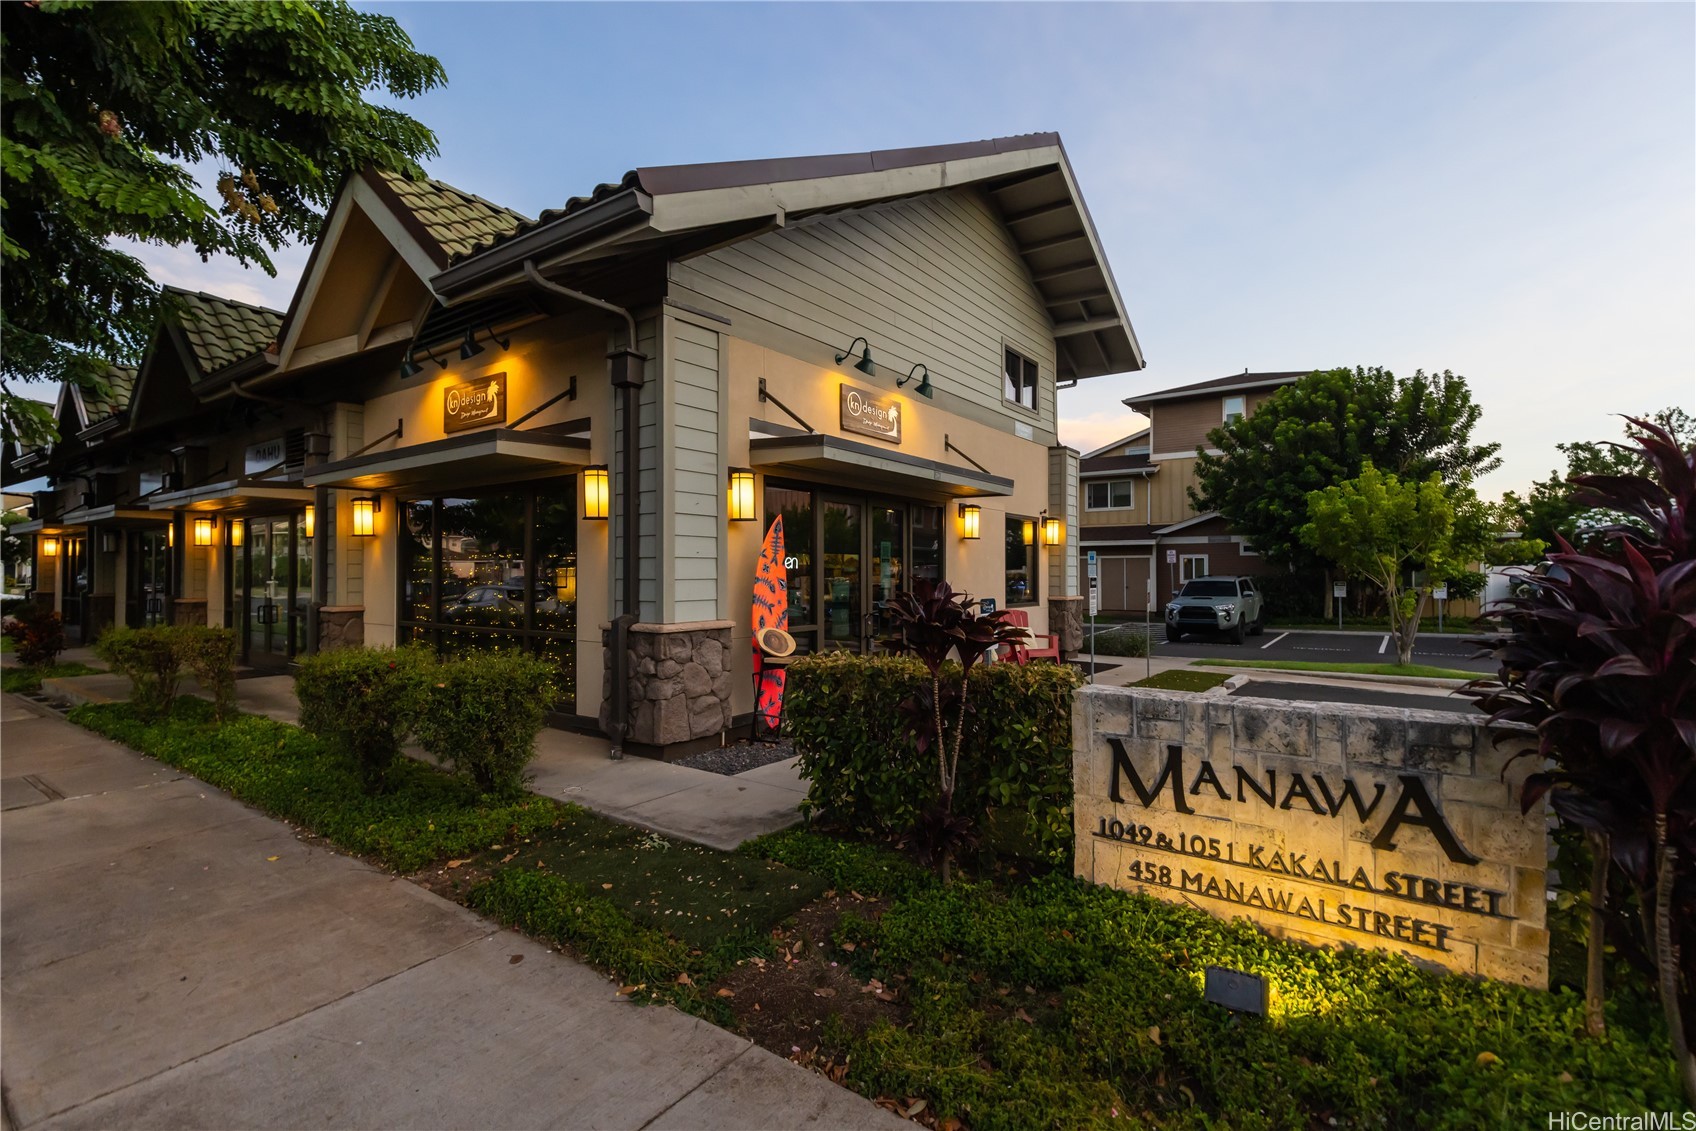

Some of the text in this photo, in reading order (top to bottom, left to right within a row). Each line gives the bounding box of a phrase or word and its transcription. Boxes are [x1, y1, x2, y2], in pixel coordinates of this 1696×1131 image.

[461, 392, 486, 406] design
[862, 401, 888, 420] design
[255, 445, 280, 464] OAHU
[784, 556, 799, 570] en
[1248, 844, 1375, 893] KAKALA
[1384, 870, 1507, 918] STREET
[1128, 860, 1454, 950] 458 MANAWAI STREET
